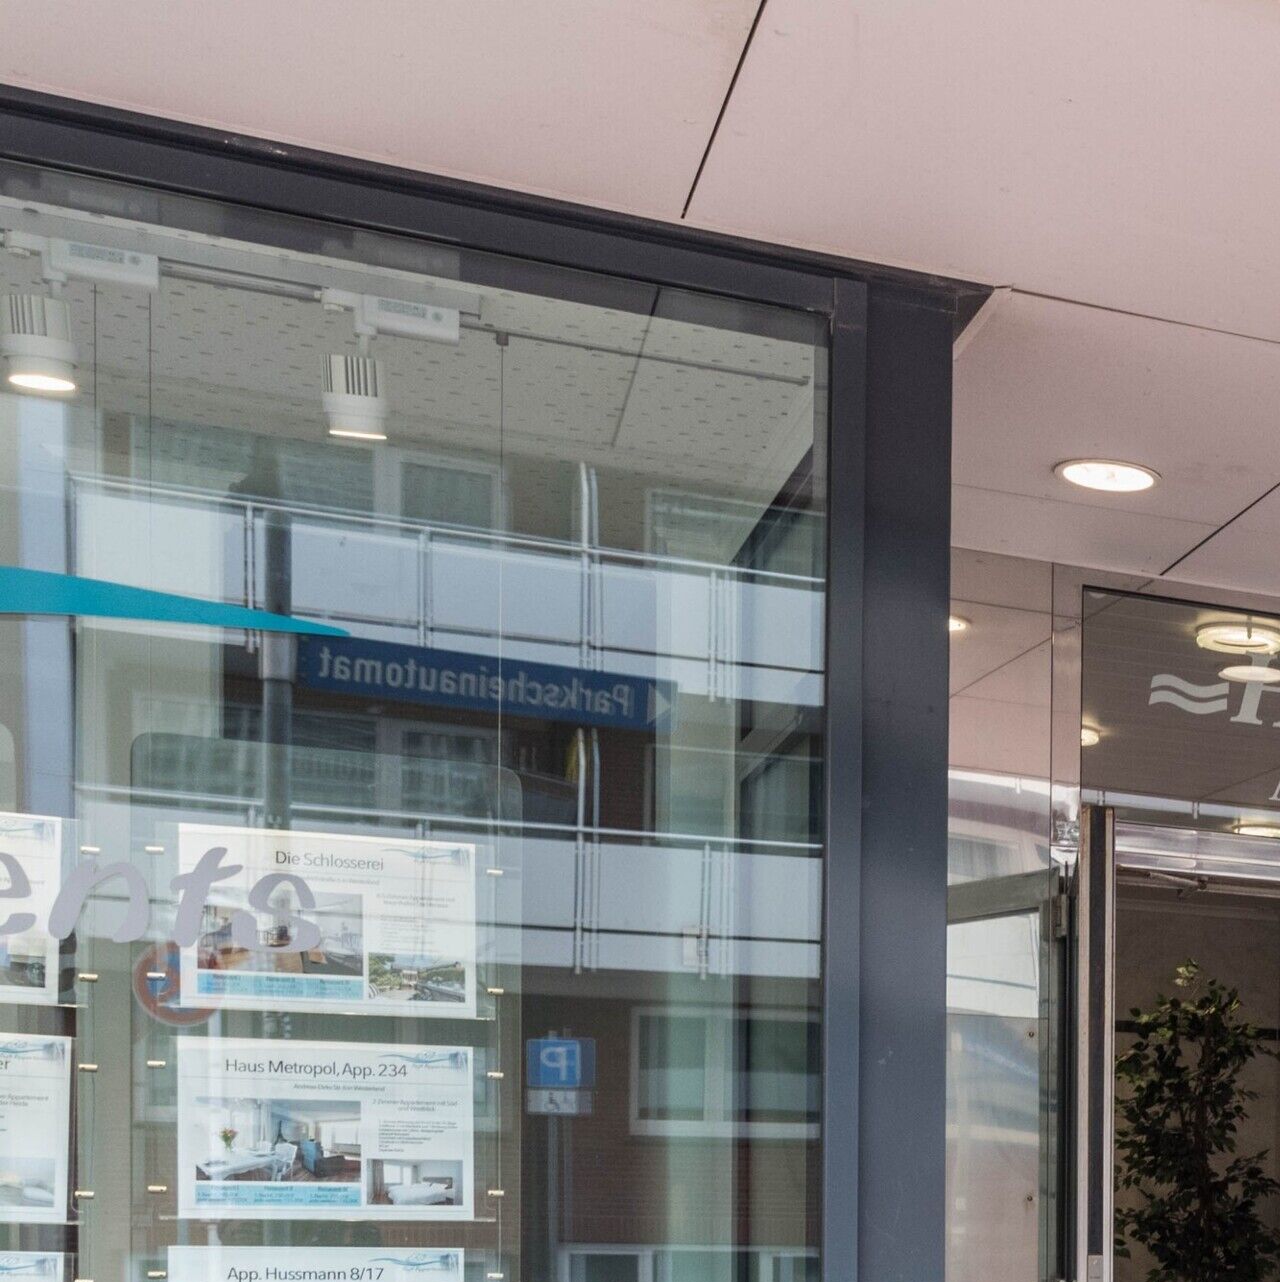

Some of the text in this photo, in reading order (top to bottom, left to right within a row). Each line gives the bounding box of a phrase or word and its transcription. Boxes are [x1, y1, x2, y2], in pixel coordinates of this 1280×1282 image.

[275, 850, 384, 872] Die Schlosserei
[225, 1059, 265, 1074] Haus
[268, 1060, 339, 1078] Metropol,
[342, 1063, 375, 1080] App.
[378, 1064, 408, 1078] 234
[227, 1266, 384, 1282] App. Hussmann 8/17
